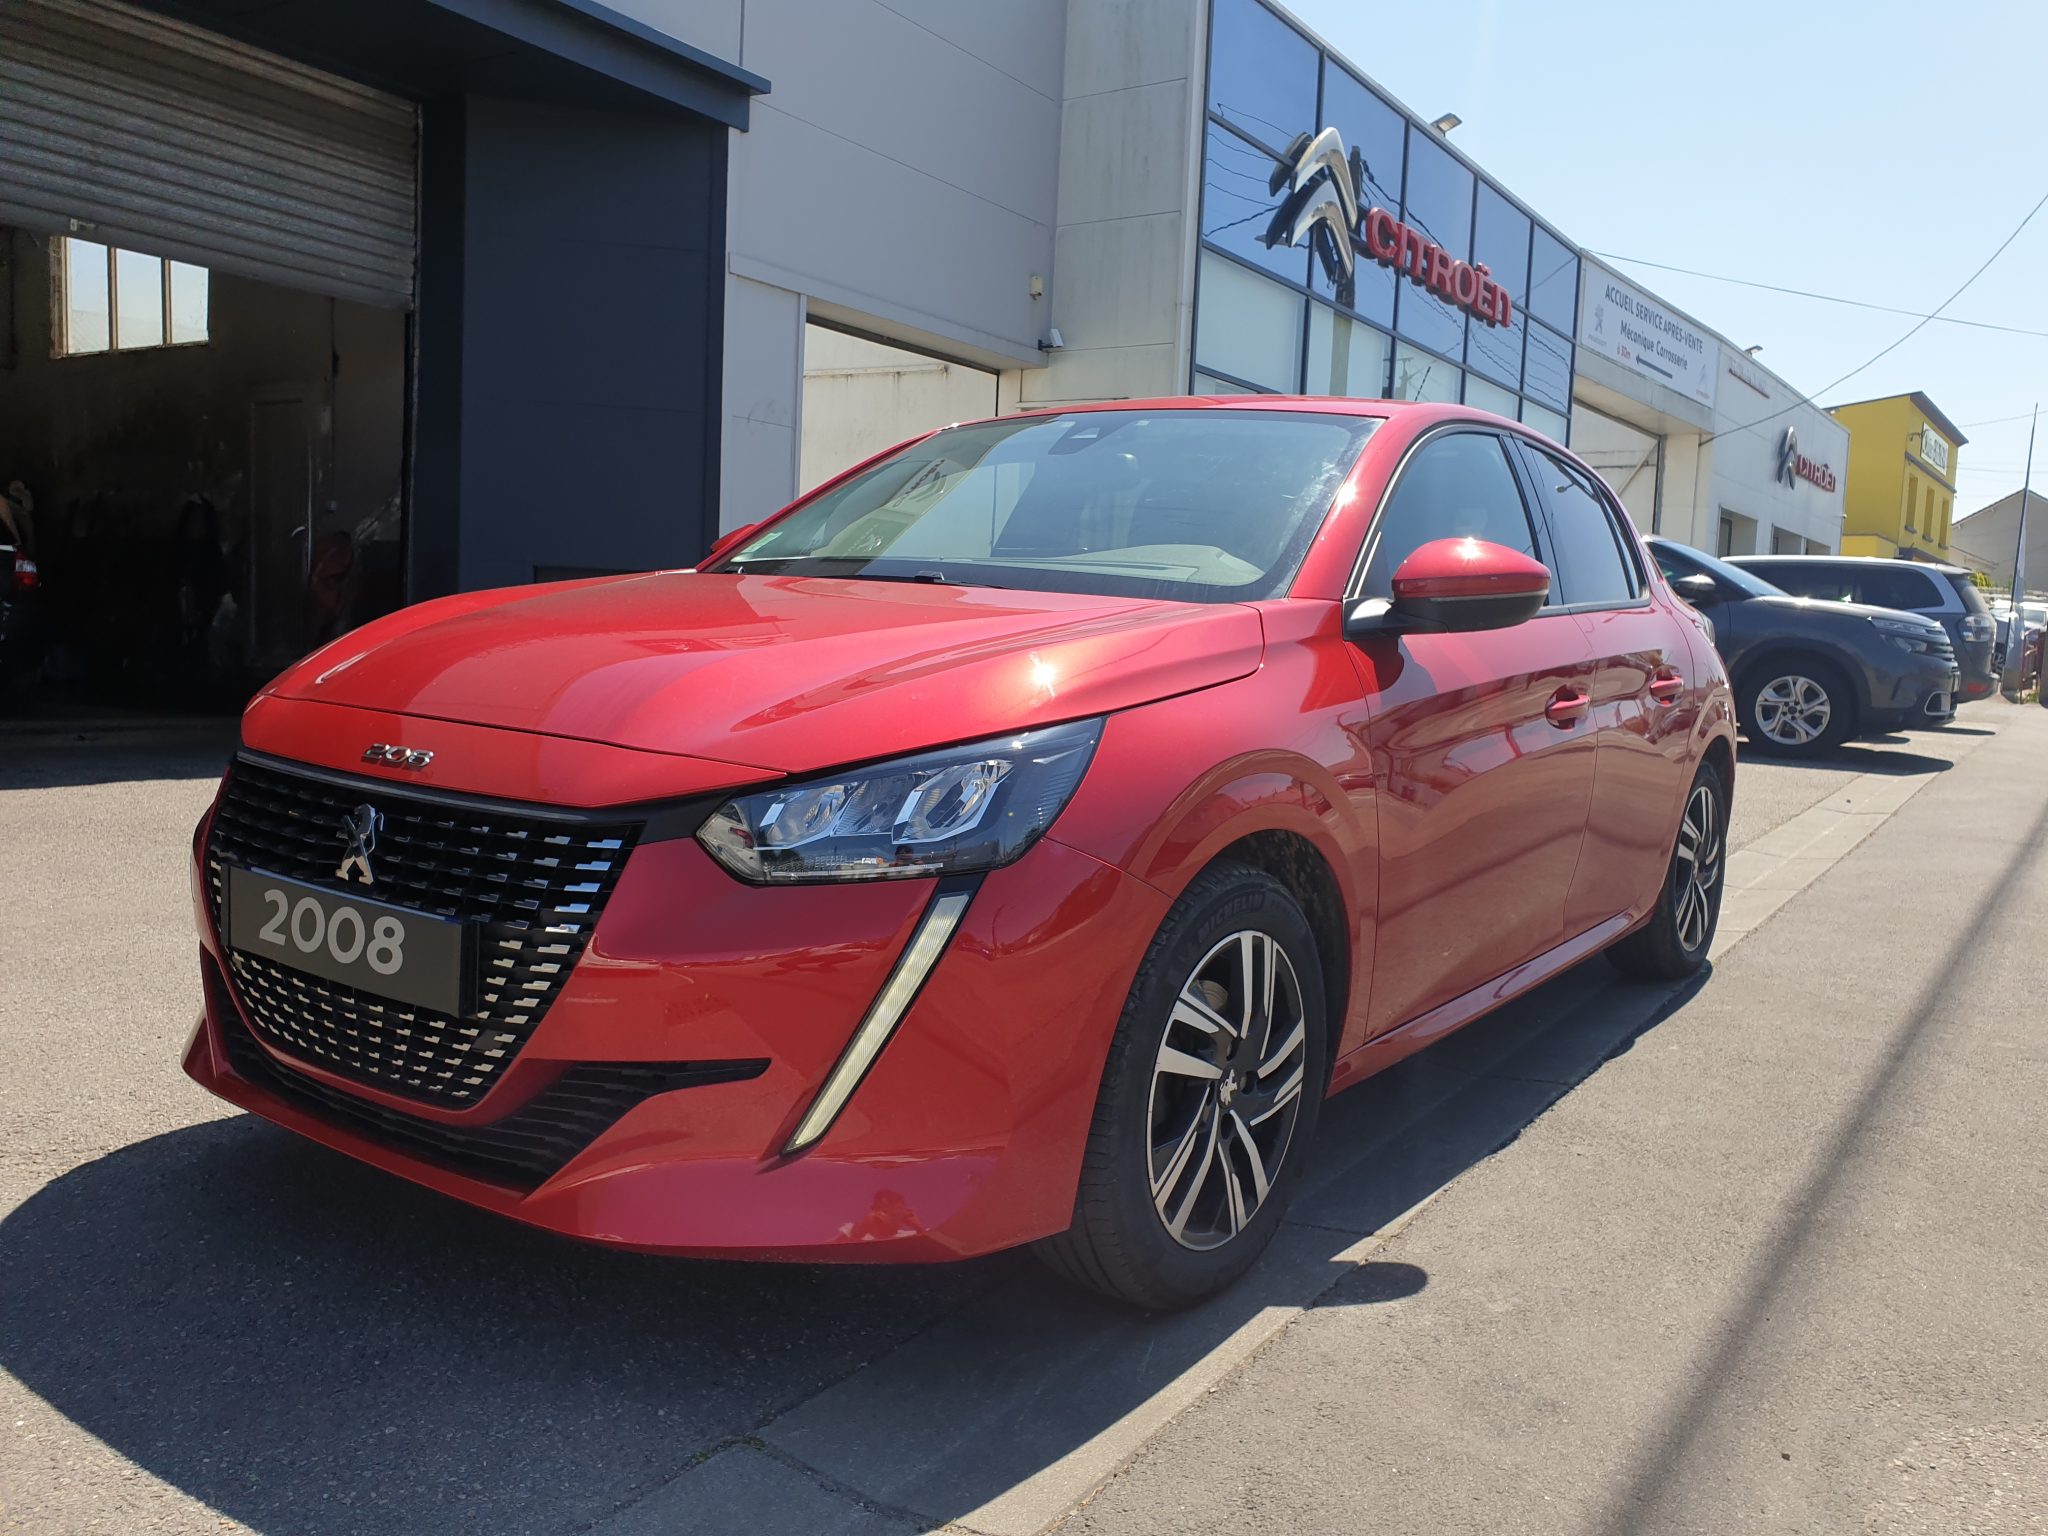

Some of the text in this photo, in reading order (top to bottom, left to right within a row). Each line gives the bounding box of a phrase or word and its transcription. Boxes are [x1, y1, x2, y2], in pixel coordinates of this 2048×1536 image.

[1366, 207, 1512, 328] CITROËN
[1605, 284, 1704, 355] ACCUEIL SERVICE APRÈS-VENTE
[1620, 319, 1688, 371] Mécanique Carrosserie
[363, 743, 434, 767] 208
[259, 889, 405, 975] 2008
